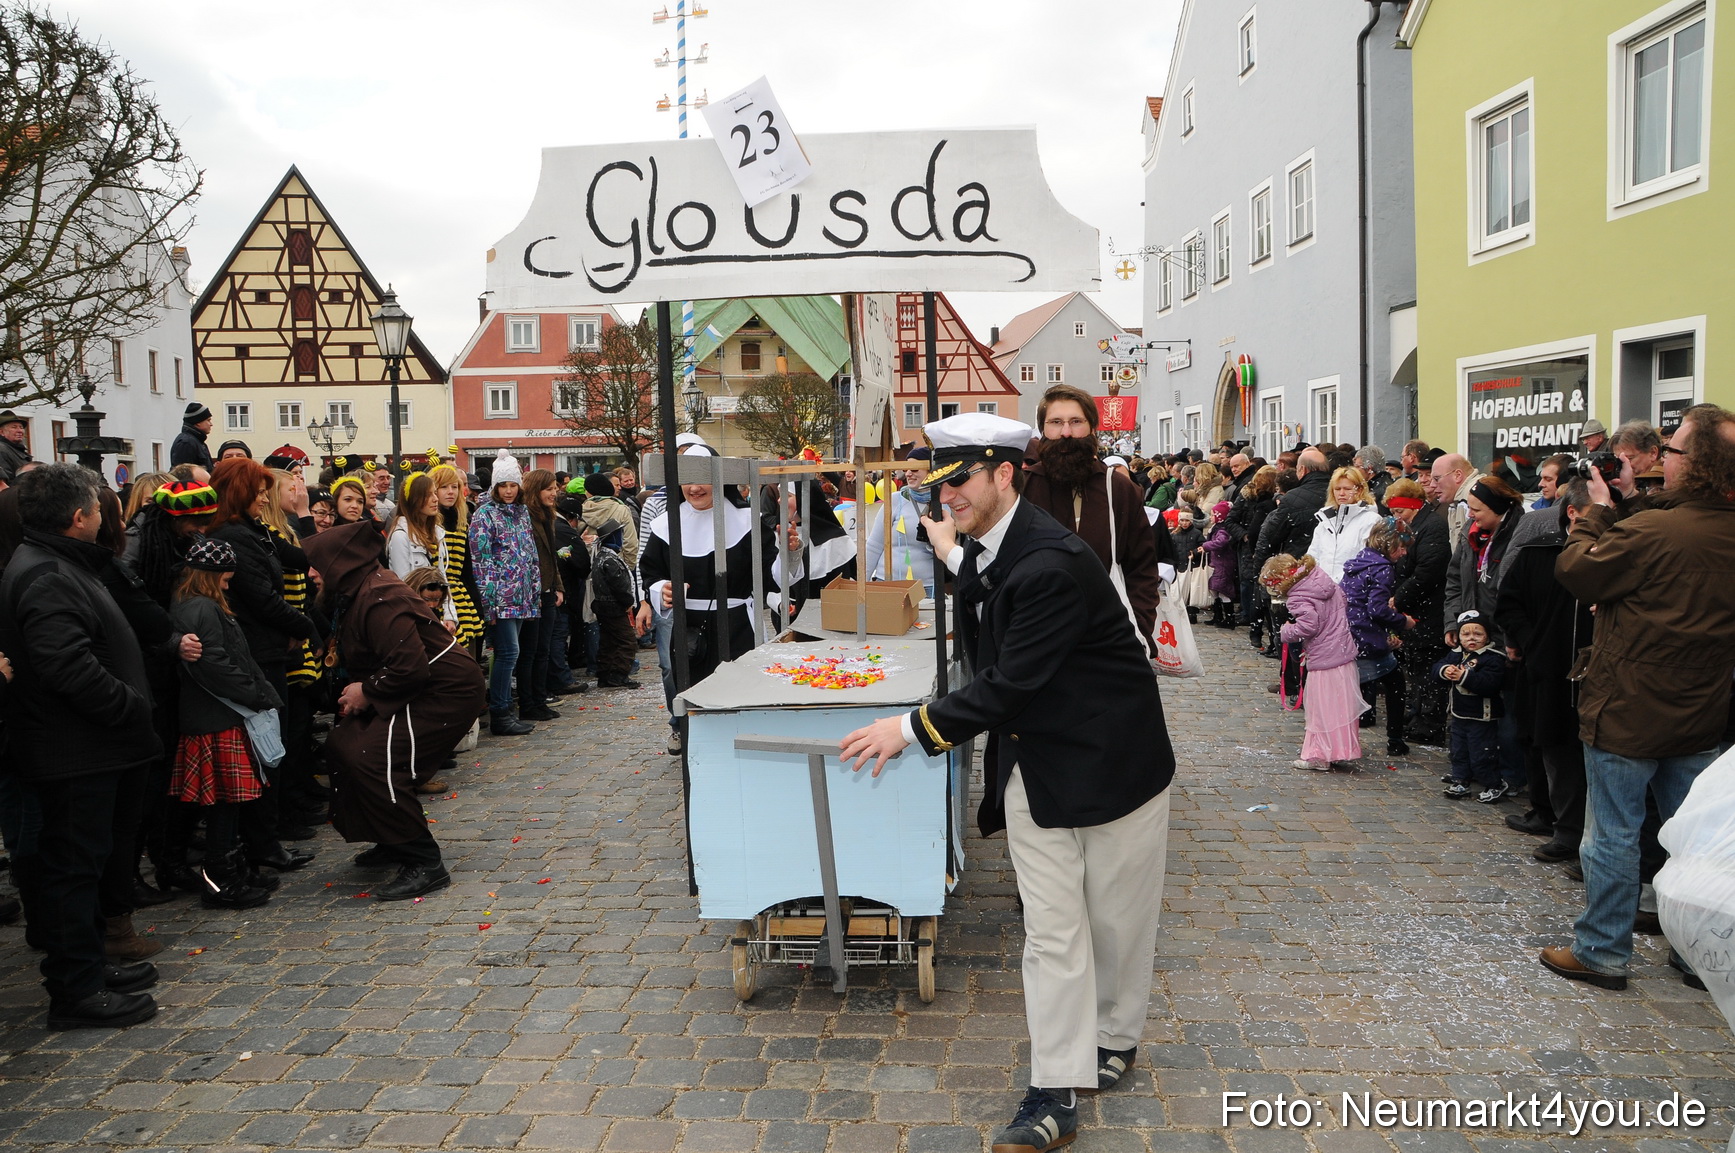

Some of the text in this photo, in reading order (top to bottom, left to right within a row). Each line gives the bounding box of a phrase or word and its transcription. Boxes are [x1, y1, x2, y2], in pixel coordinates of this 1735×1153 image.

[730, 110, 781, 169] 23
[1472, 377, 1523, 392] FAHRSCHULE
[1471, 389, 1584, 420] HOFBAUER &
[524, 429, 552, 437] Riebe
[1495, 423, 1583, 449] DECHANT
[848, 517, 857, 531] 2
